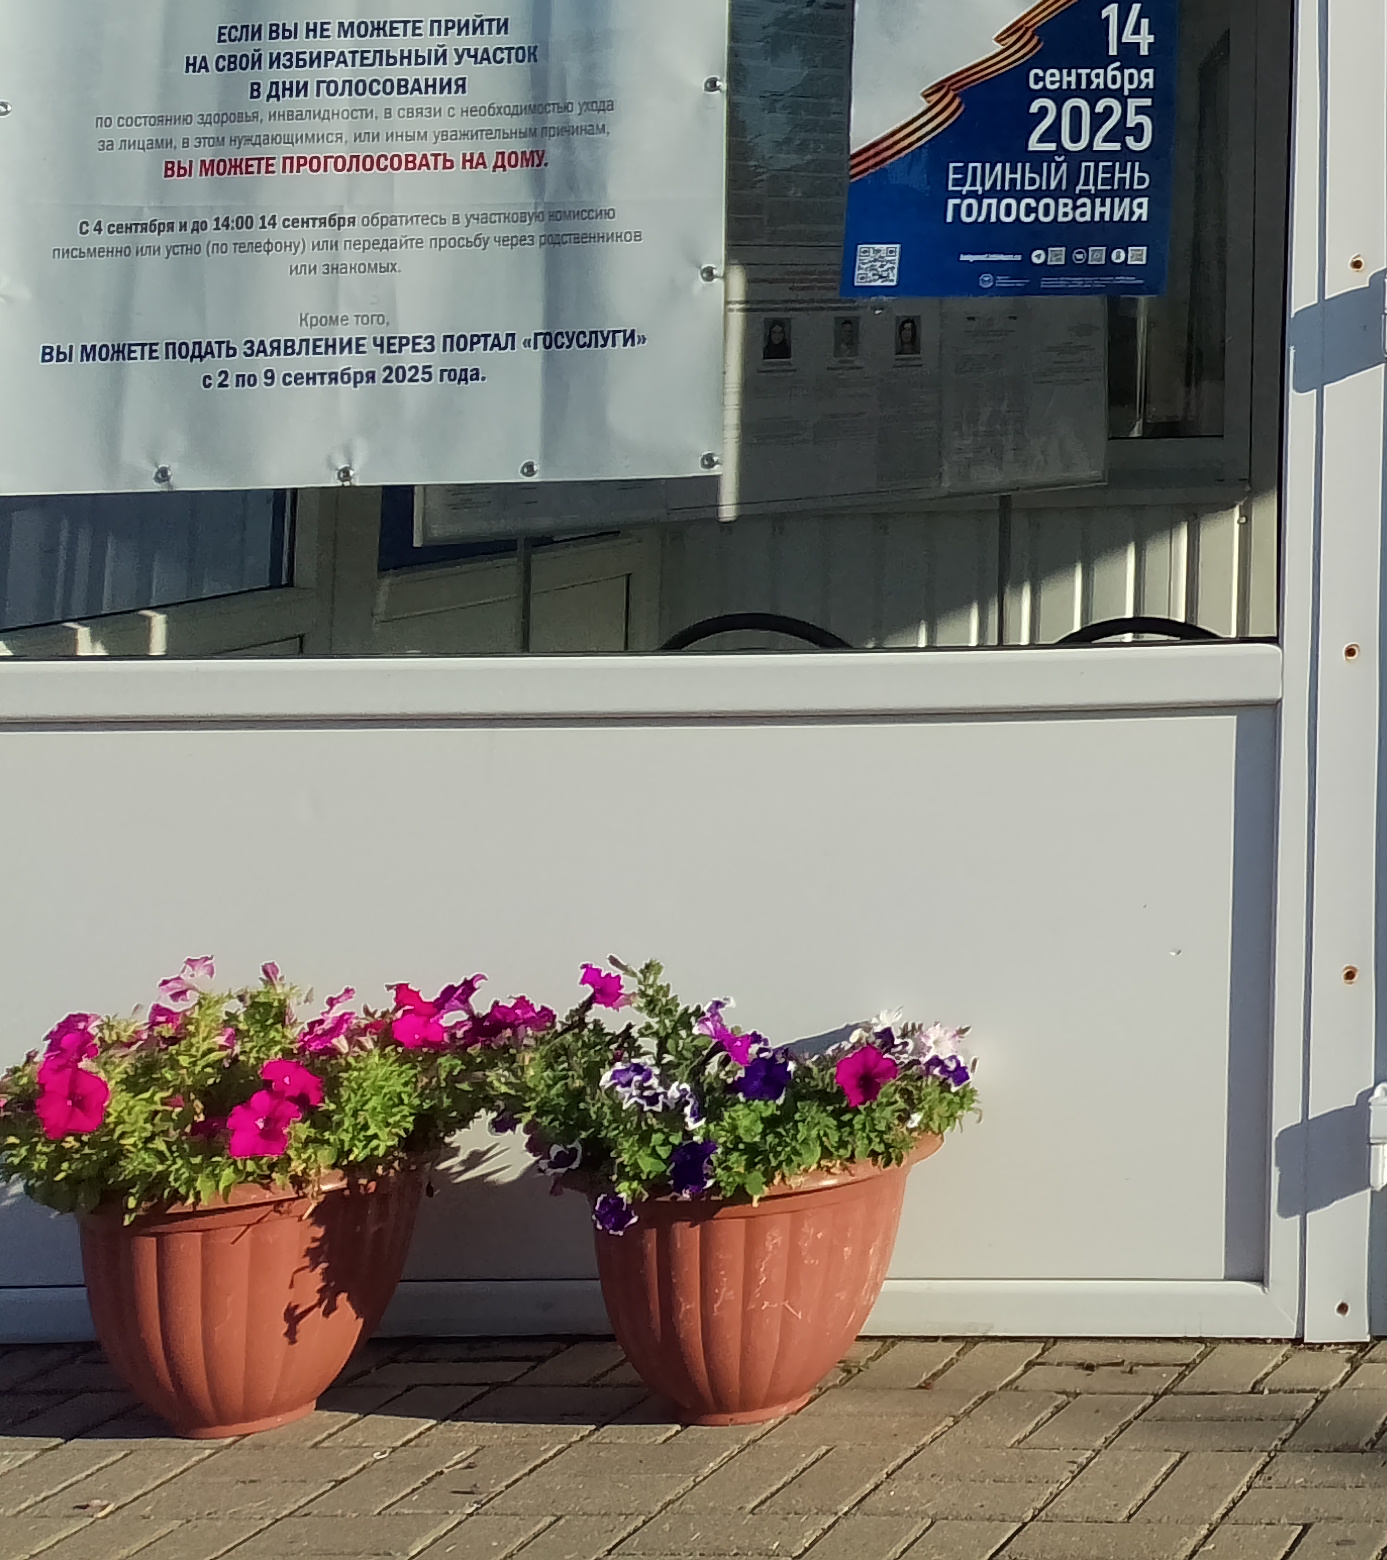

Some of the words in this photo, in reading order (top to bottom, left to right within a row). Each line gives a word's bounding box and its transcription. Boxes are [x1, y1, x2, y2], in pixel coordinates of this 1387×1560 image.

[217, 22, 263, 43] ЕСЛИ
[268, 21, 298, 41] ВЫ
[305, 20, 331, 40] НЕ
[337, 18, 422, 39] МОЖЕТЕ
[429, 12, 509, 37] ПРИЙТИ
[1100, 2, 1154, 55] 14
[184, 54, 208, 74] НА
[214, 47, 262, 72] СВОЙ
[268, 42, 448, 70] ИЗБИРАТЕЛЬНЫЙ
[454, 45, 539, 67] УЧАСТОК
[250, 80, 262, 99] В
[266, 79, 309, 102] ДНИ
[315, 76, 466, 98] ГОЛОСОВАНИЯ
[1028, 63, 1154, 95] сентября
[96, 116, 112, 128] по
[117, 114, 193, 127] состоянию
[197, 111, 263, 127] здоровья,
[268, 106, 378, 123] инвалидности,
[384, 108, 392, 119] в
[397, 107, 441, 118] связи
[447, 107, 456, 118] с
[461, 101, 573, 117] необходимостью
[577, 99, 615, 115] ухода
[1028, 98, 1153, 152] 2025
[98, 139, 113, 151] за
[118, 138, 177, 153] лицами,
[182, 138, 189, 148] в
[194, 136, 225, 148] этом
[354, 131, 381, 143] или
[385, 130, 428, 142] иным
[432, 125, 537, 144] уважительным
[164, 160, 193, 179] ВЫ
[199, 157, 276, 178] МОЖЕТЕ
[282, 152, 455, 175] ПРОГОЛОСОВАТЬ
[461, 152, 488, 171] НА
[493, 149, 548, 173] ДОМУ.
[948, 155, 1068, 193] ЕДИНЫЙ
[1075, 162, 1150, 195] ДЕНЬ
[93, 221, 102, 235] 4
[107, 218, 174, 236] сентября
[179, 221, 187, 232] и
[191, 221, 208, 235] до
[212, 216, 253, 230] 14:00
[259, 215, 277, 229] 14
[281, 213, 356, 232] сентября
[361, 212, 447, 229] обратитесь
[452, 213, 460, 225] в
[464, 210, 545, 227] участковую
[549, 207, 616, 221] комиссию
[52, 246, 131, 259] письменно
[135, 245, 161, 257] или
[165, 244, 201, 259] устно
[206, 241, 228, 258] (по
[232, 238, 306, 255] телефону)
[311, 239, 338, 251] или
[343, 235, 424, 253] передайте
[429, 233, 488, 252] просьбу
[494, 234, 534, 249] через
[539, 230, 643, 248] родственников
[289, 263, 317, 276] или
[321, 261, 402, 276] знакомых.
[299, 311, 349, 330] Кроме
[354, 311, 390, 329] того,
[40, 345, 73, 365] ВЫ
[79, 342, 159, 363] МОЖЕТЕ
[165, 339, 237, 363] ПОДАТЬ
[243, 337, 367, 358] ЗАЯВЛЕНИЕ
[372, 335, 436, 354] ЧЕРЕЗ
[442, 333, 516, 353] ПОРТАЛ
[522, 330, 646, 350] «ГОСУСЛУГИ»
[202, 373, 214, 389] с
[218, 369, 229, 388] 2
[234, 372, 258, 389] по
[263, 367, 276, 387] 9
[282, 363, 376, 390] сентября
[382, 364, 432, 385] 2025
[438, 364, 486, 385] года.
